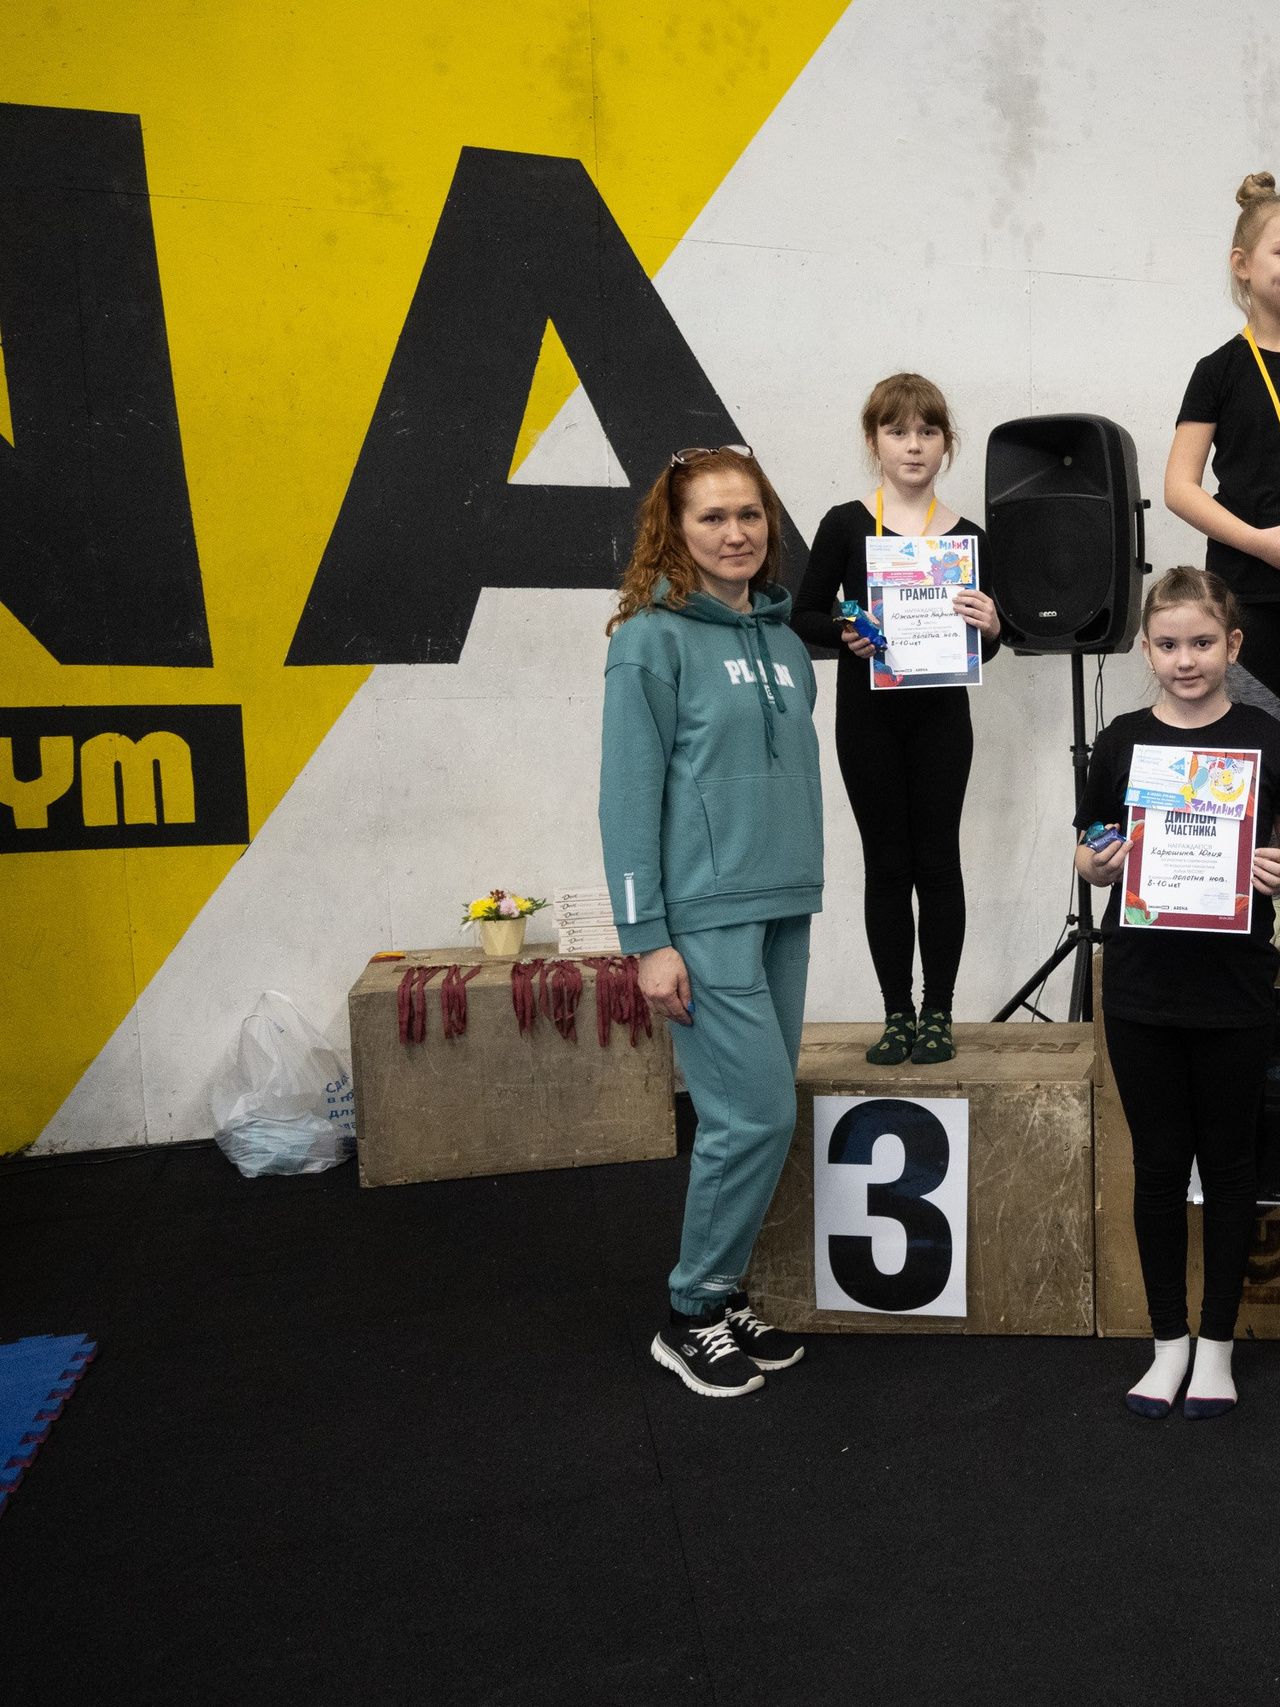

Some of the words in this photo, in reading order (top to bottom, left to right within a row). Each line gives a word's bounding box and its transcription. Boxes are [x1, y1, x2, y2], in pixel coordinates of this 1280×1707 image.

[900, 587, 948, 601] ГРАМОТА
[1165, 824, 1216, 836] УЧАСТНИКА
[1147, 879, 1167, 887] 8-10
[828, 1098, 953, 1312] 3
